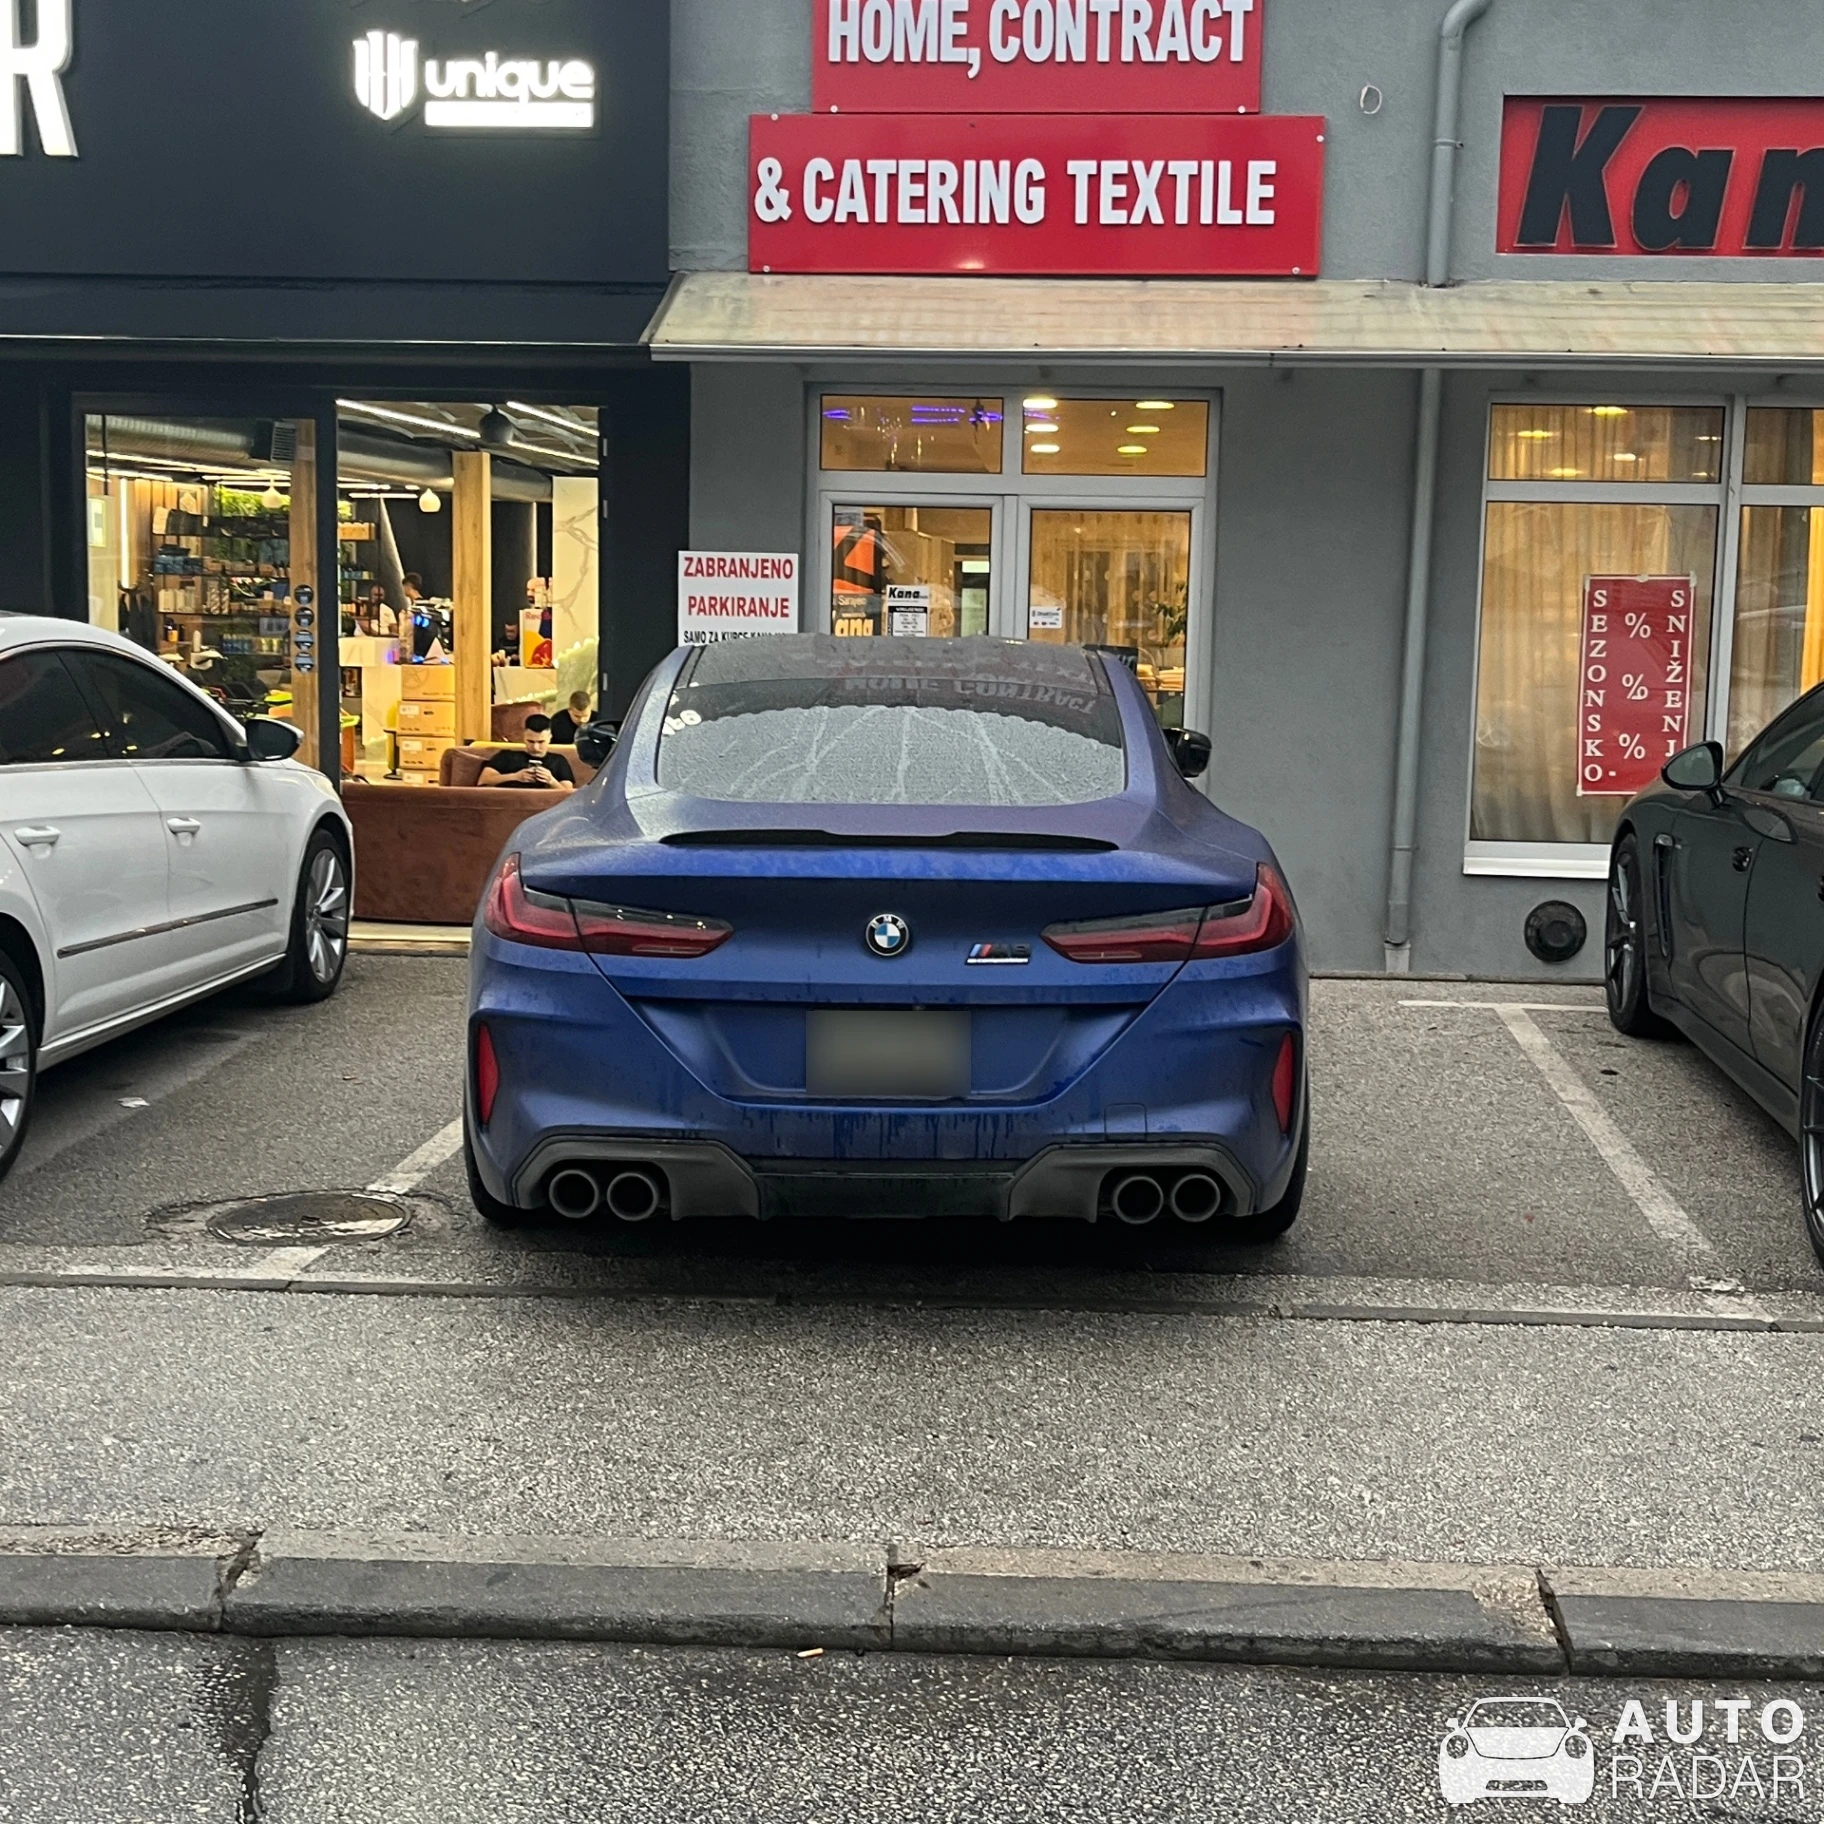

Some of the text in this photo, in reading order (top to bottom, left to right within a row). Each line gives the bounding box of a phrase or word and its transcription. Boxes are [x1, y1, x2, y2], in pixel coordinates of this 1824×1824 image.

[989, 0, 1253, 62] CONTRACT
[425, 51, 594, 104] unique
[754, 157, 1277, 225] & CATERING TEXTILE
[1513, 104, 1824, 251] Kan
[683, 556, 794, 579] ZABRANJENO
[688, 595, 790, 618] PARKIRANJE
[888, 587, 920, 599] Kana
[684, 630, 707, 643] SAMO
[708, 631, 719, 643] ZA
[832, 611, 874, 637] ana
[1661, 589, 1687, 758] SNIŽENJ
